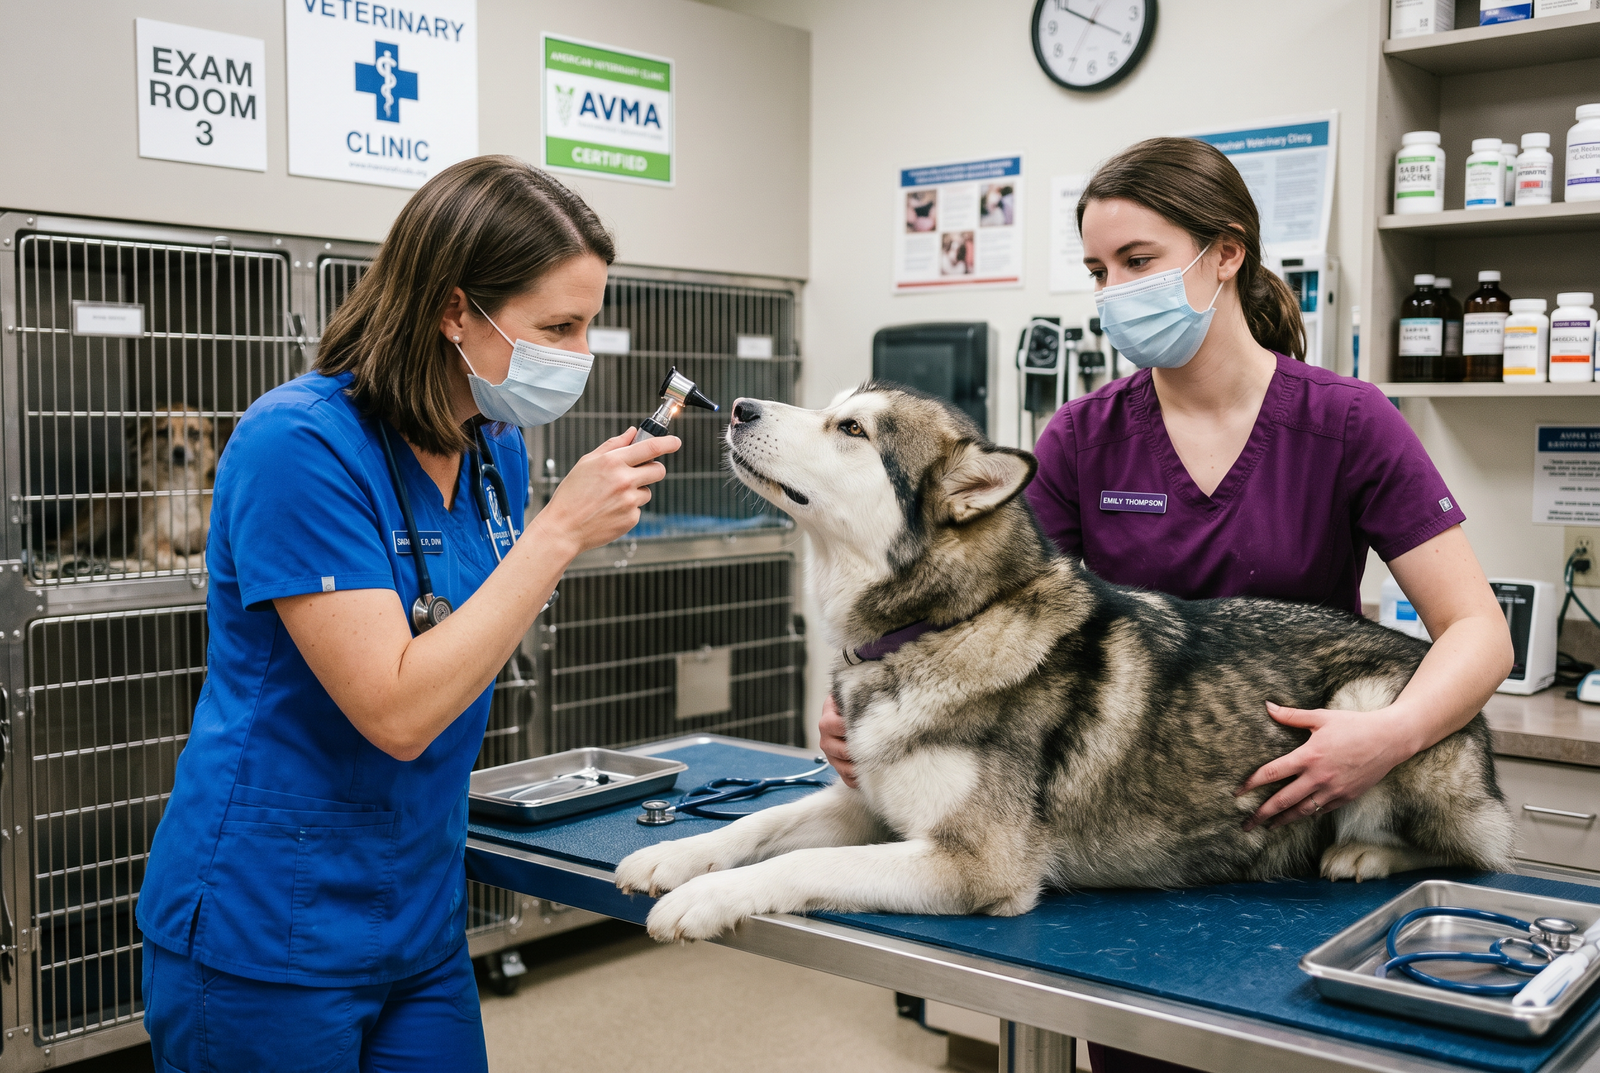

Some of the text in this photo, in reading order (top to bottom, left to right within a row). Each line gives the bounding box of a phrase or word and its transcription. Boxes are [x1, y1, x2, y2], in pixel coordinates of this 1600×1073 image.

[304, 0, 464, 42] VETERINARY
[1128, 5, 1139, 21] 3
[1048, 20, 1058, 36] 9
[1121, 32, 1132, 45] 4
[1053, 43, 1064, 58] 8
[153, 46, 252, 87] EXAM
[1068, 57, 1078, 73] 7
[1107, 51, 1118, 67] 5
[1087, 60, 1097, 75] 6
[150, 80, 256, 120] ROOM
[580, 92, 662, 129] AVMA
[196, 120, 214, 146] 3
[347, 131, 429, 162] CLINIC
[571, 146, 648, 172] CERTIFIED
[1103, 497, 1163, 507] EMILY THOMPSON
